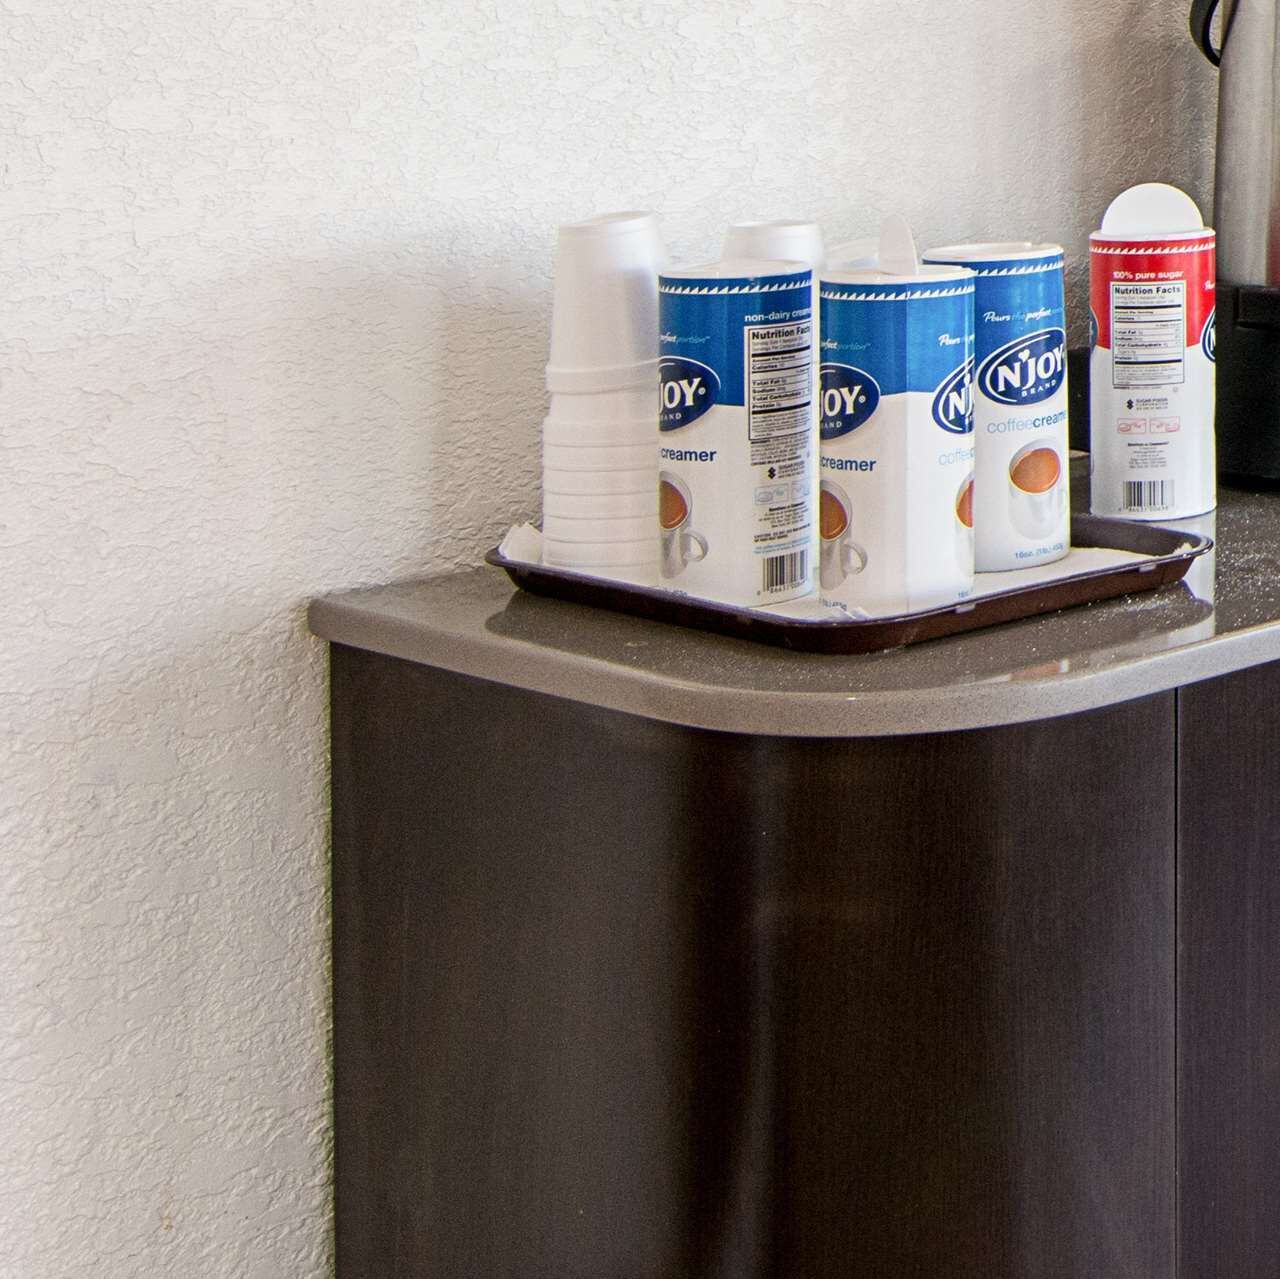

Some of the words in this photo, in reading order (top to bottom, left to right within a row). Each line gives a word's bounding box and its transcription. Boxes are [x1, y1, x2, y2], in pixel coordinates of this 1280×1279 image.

[1113, 270, 1134, 279] 100%
[1135, 272, 1155, 280] pure
[1158, 271, 1184, 279] sugar
[1115, 286, 1153, 295] Nutrition
[744, 310, 791, 322] non-dairy
[752, 328, 795, 340] Nutrition
[659, 377, 702, 413] JOY
[1021, 380, 1057, 397] BRAND
[819, 385, 862, 420] JOY
[661, 447, 717, 462] creamer
[820, 455, 877, 471] creamer
